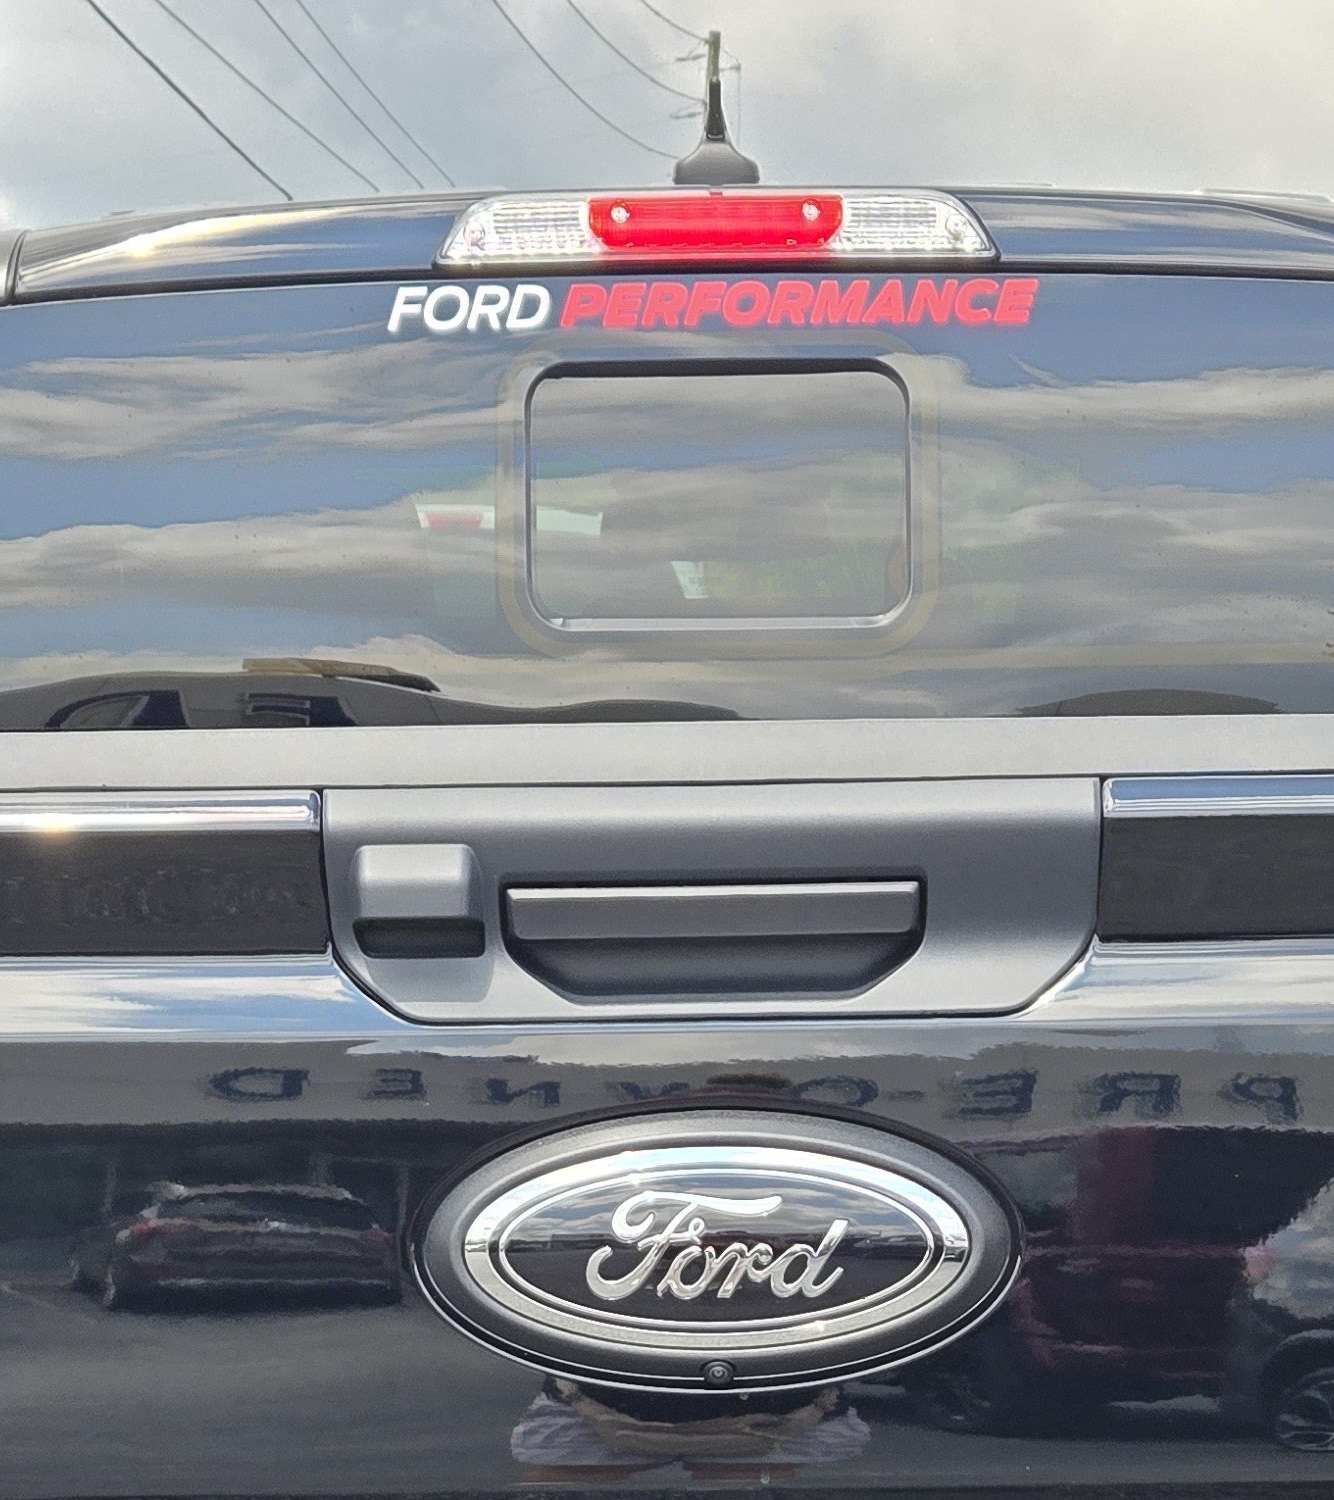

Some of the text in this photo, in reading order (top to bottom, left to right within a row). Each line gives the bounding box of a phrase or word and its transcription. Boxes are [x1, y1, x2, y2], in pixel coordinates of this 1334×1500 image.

[387, 277, 1039, 332] FORD PERFORMANCE
[584, 1188, 849, 1301] Ford
